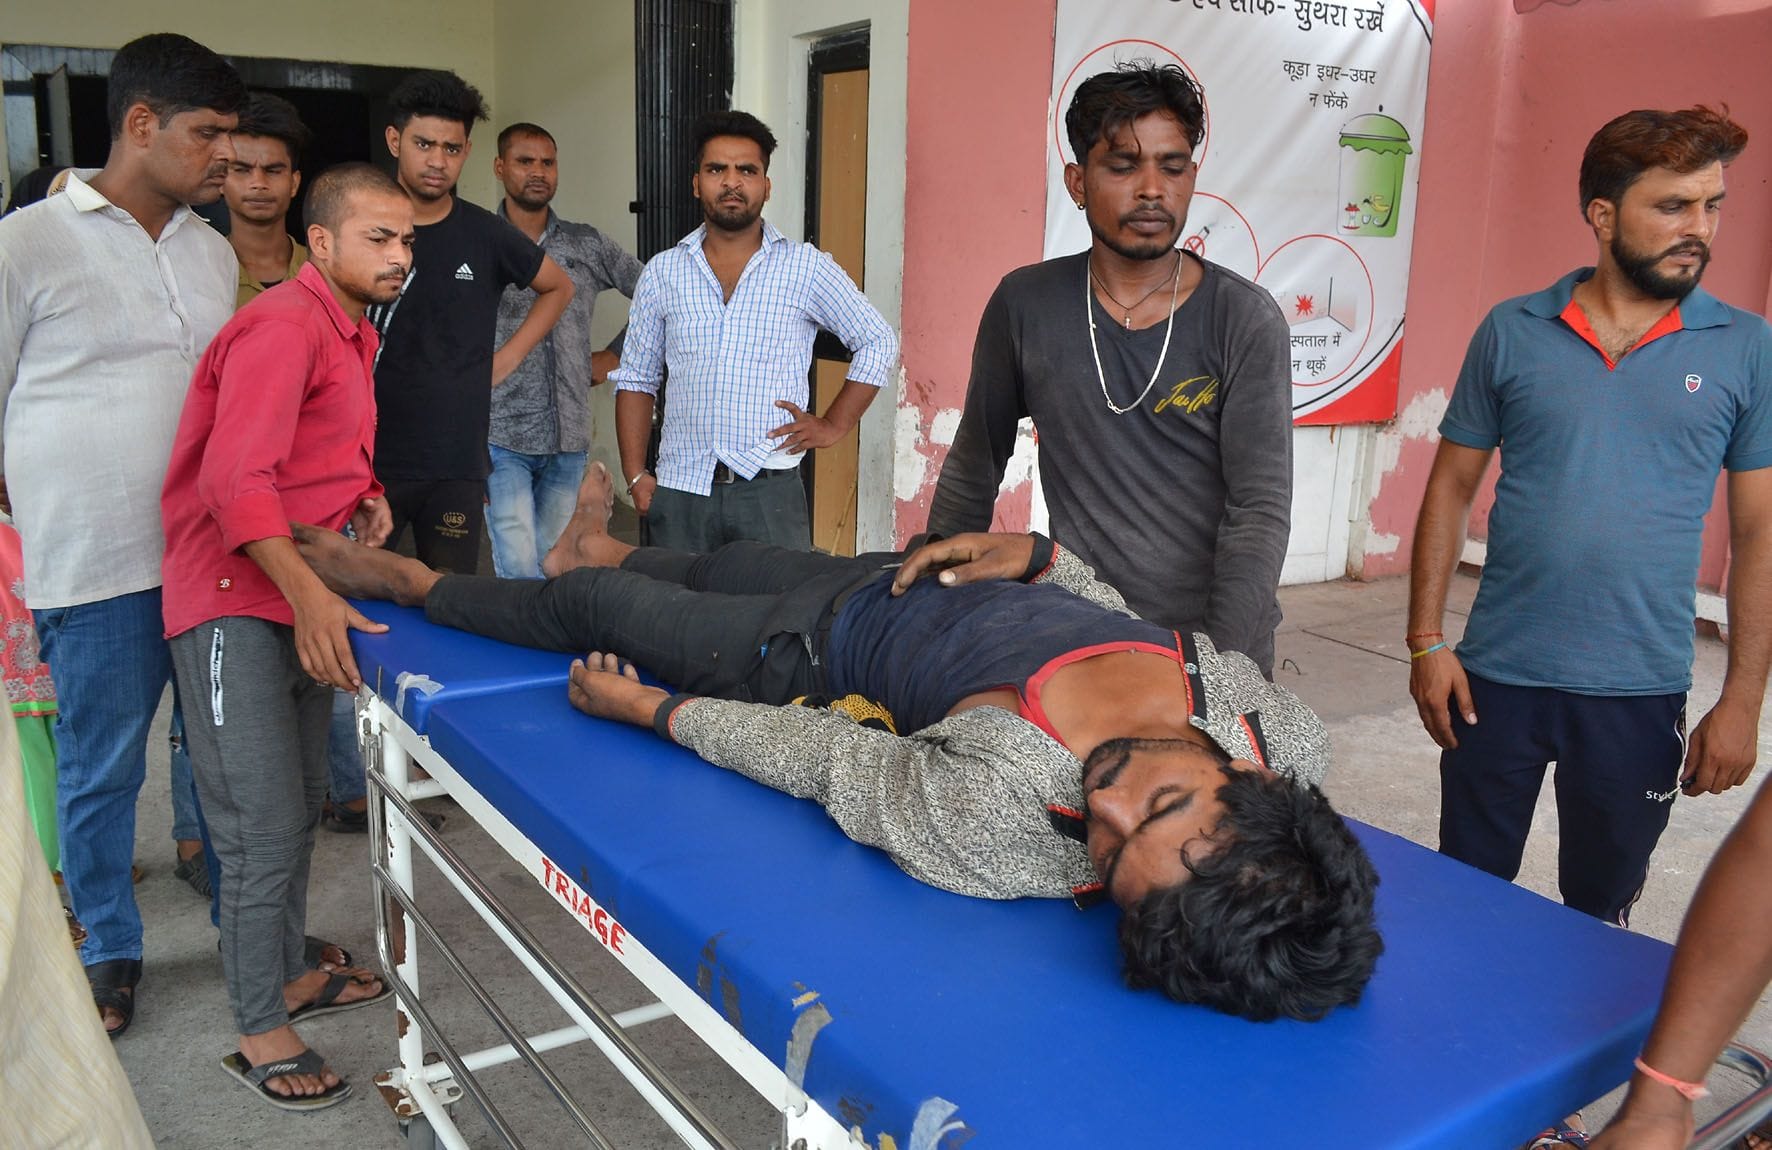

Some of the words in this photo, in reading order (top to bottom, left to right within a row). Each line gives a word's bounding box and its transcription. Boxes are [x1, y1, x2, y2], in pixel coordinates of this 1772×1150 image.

[1294, 0, 1348, 31] सुथरा
[1354, 1, 1384, 32] रखें
[1282, 60, 1311, 81] कूड़ा
[1309, 92, 1319, 107] न
[1290, 335, 1328, 347] स्पताल
[1332, 331, 1342, 347] में
[1292, 360, 1302, 372] न
[1306, 355, 1327, 377] थूकें
[541, 857, 626, 955] TRIAGE
